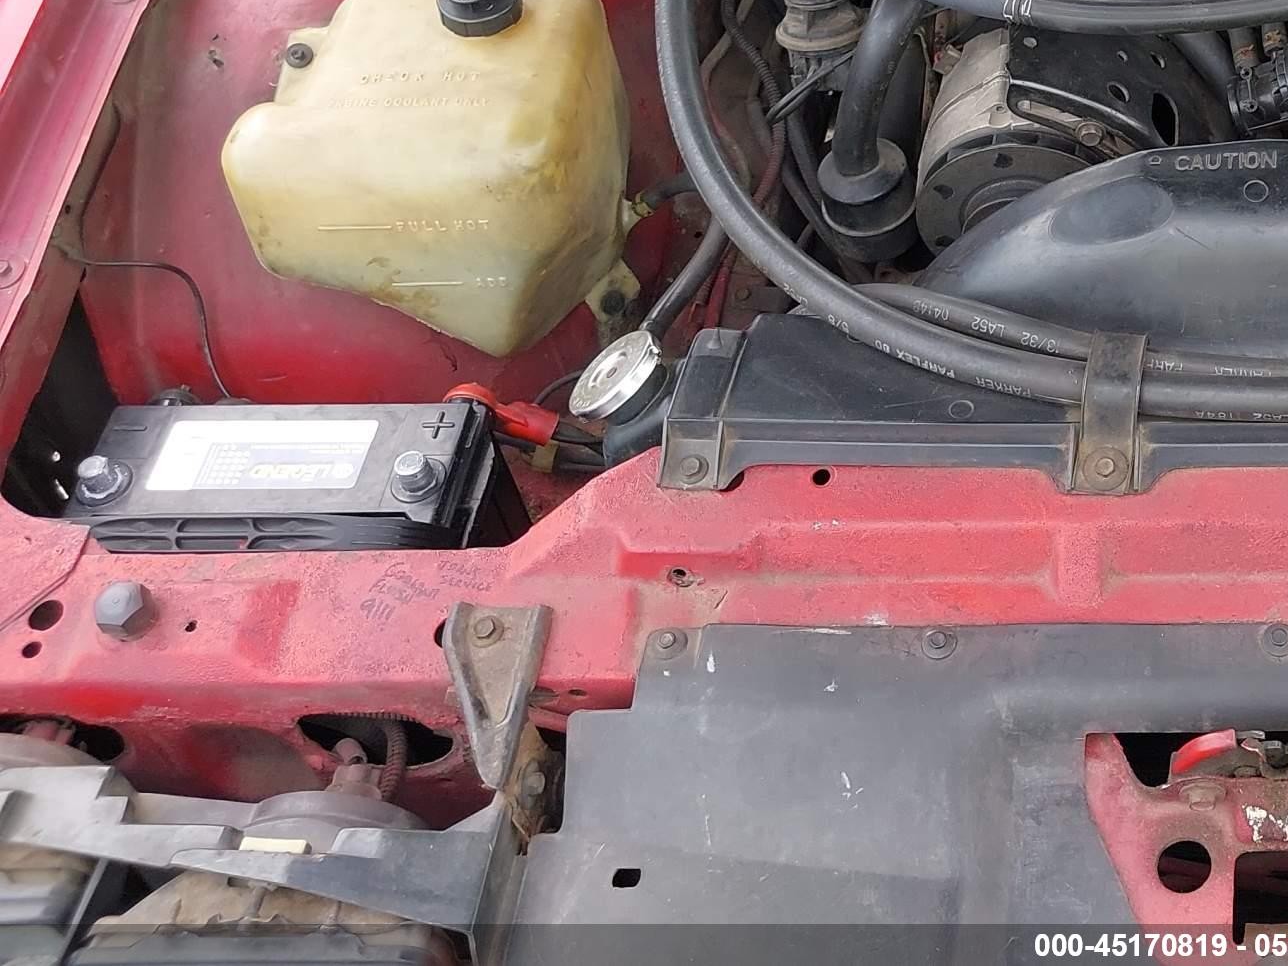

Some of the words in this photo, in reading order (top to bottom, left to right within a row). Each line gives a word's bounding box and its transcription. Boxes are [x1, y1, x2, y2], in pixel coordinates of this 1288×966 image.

[359, 70, 425, 85] CHECK
[441, 70, 481, 82] HOT
[383, 97, 449, 108] COOLANT
[1174, 150, 1278, 171] CAUTION
[395, 220, 448, 232] FULL
[453, 219, 489, 231] HOT
[971, 315, 1005, 337] LA52
[896, 348, 955, 379] PARFLEX
[975, 376, 1032, 398] PARKER
